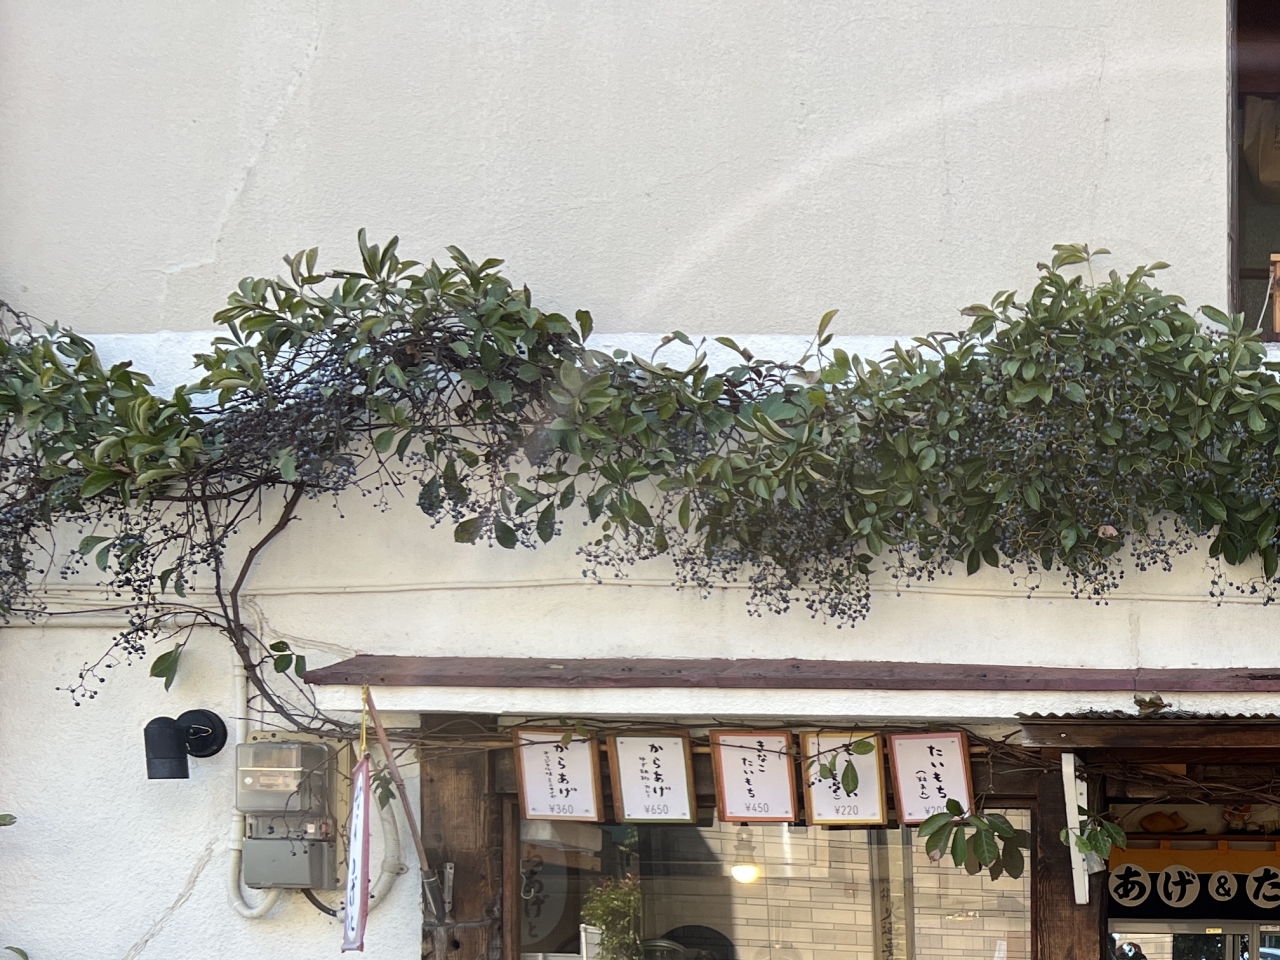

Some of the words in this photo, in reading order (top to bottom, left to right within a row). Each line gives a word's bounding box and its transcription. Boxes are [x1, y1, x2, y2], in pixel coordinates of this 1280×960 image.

[553, 743, 577, 798] からあげ
[648, 743, 671, 798] からあげ
[756, 740, 767, 773] きなこ
[927, 744, 947, 799] たいもち
[741, 757, 756, 798] たいもち
[549, 804, 574, 815] ¥360
[644, 804, 669, 815] ¥650
[744, 802, 770, 813] ¥450
[833, 805, 859, 816] ¥220
